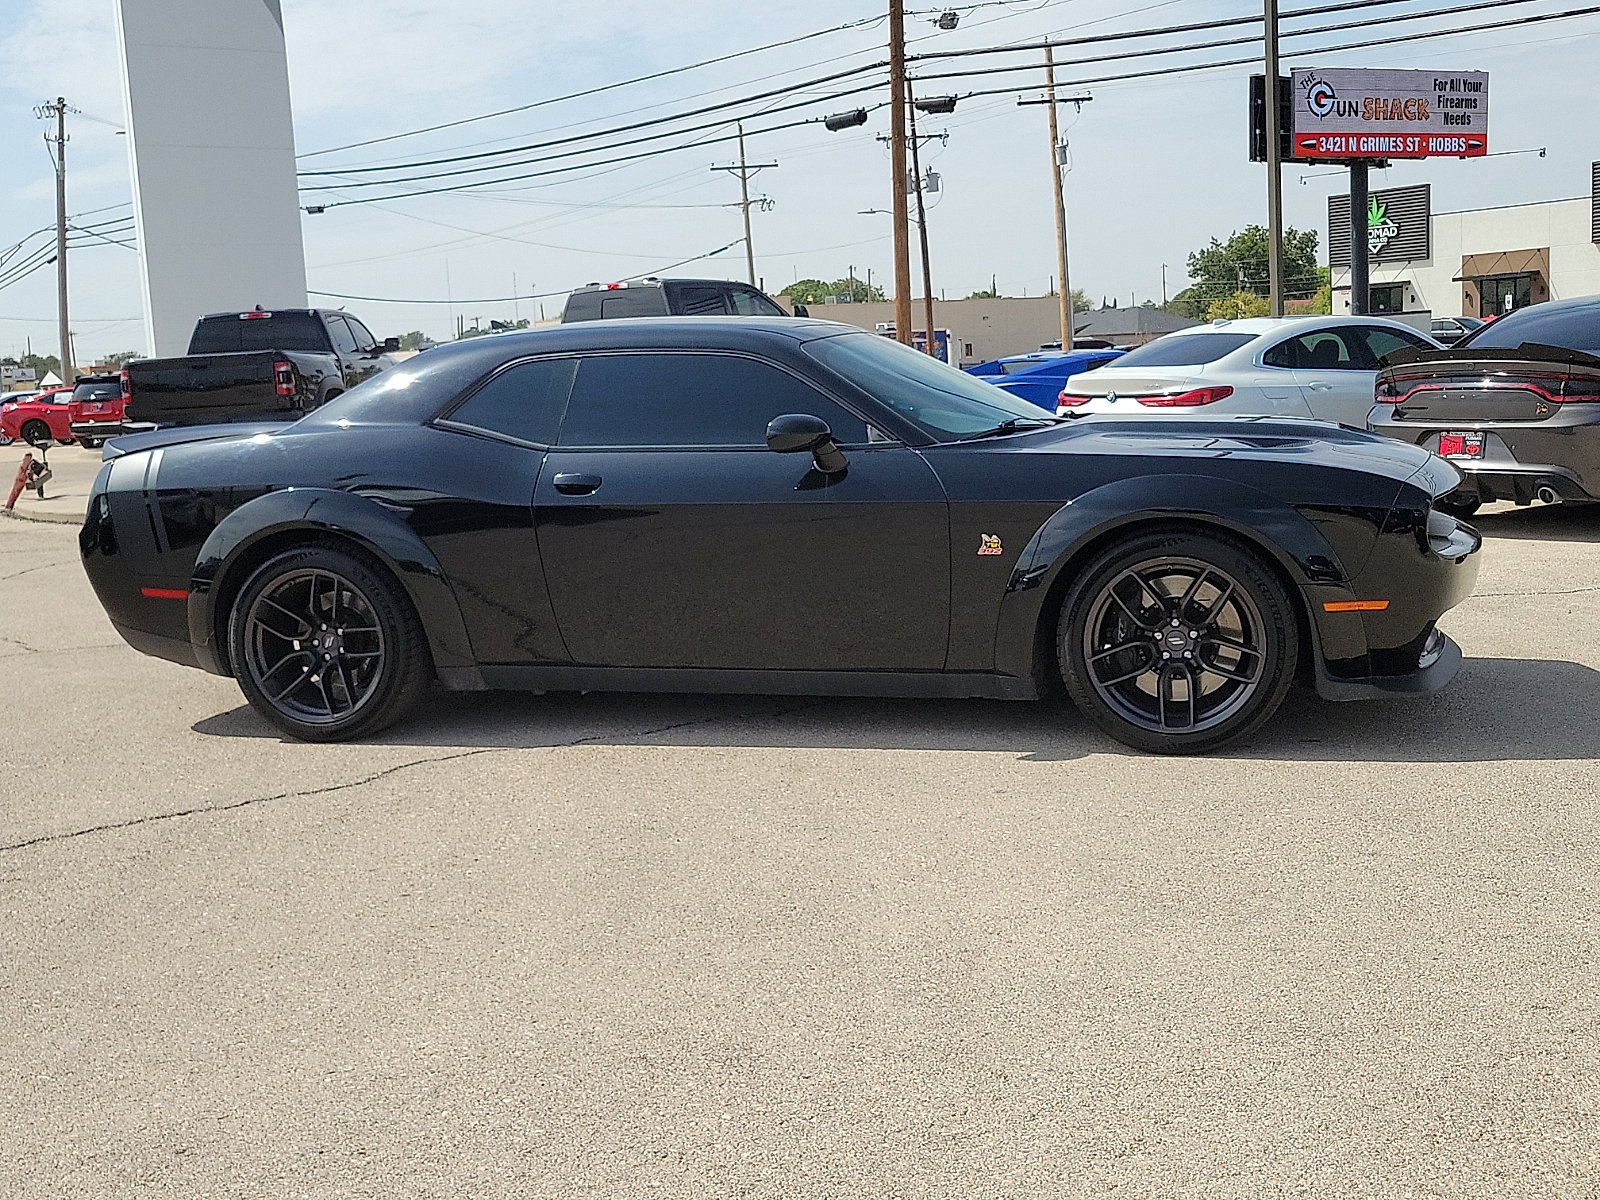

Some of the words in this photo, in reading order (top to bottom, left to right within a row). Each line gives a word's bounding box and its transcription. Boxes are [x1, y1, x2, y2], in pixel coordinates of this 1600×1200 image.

[1299, 72, 1316, 89] THE
[1433, 78, 1448, 92] For
[1449, 78, 1461, 93] All
[1462, 79, 1482, 93] Your
[1306, 78, 1359, 119] GUN
[1361, 97, 1430, 121] SHACK
[1437, 94, 1478, 109] Firearms
[1443, 112, 1472, 126] Needs
[1319, 136, 1346, 152] 3421
[1348, 136, 1357, 152] N
[1359, 136, 1402, 152] GRIMES
[1406, 137, 1421, 152] ST
[1428, 137, 1466, 152] HOBBS
[1368, 227, 1397, 238] OMAD
